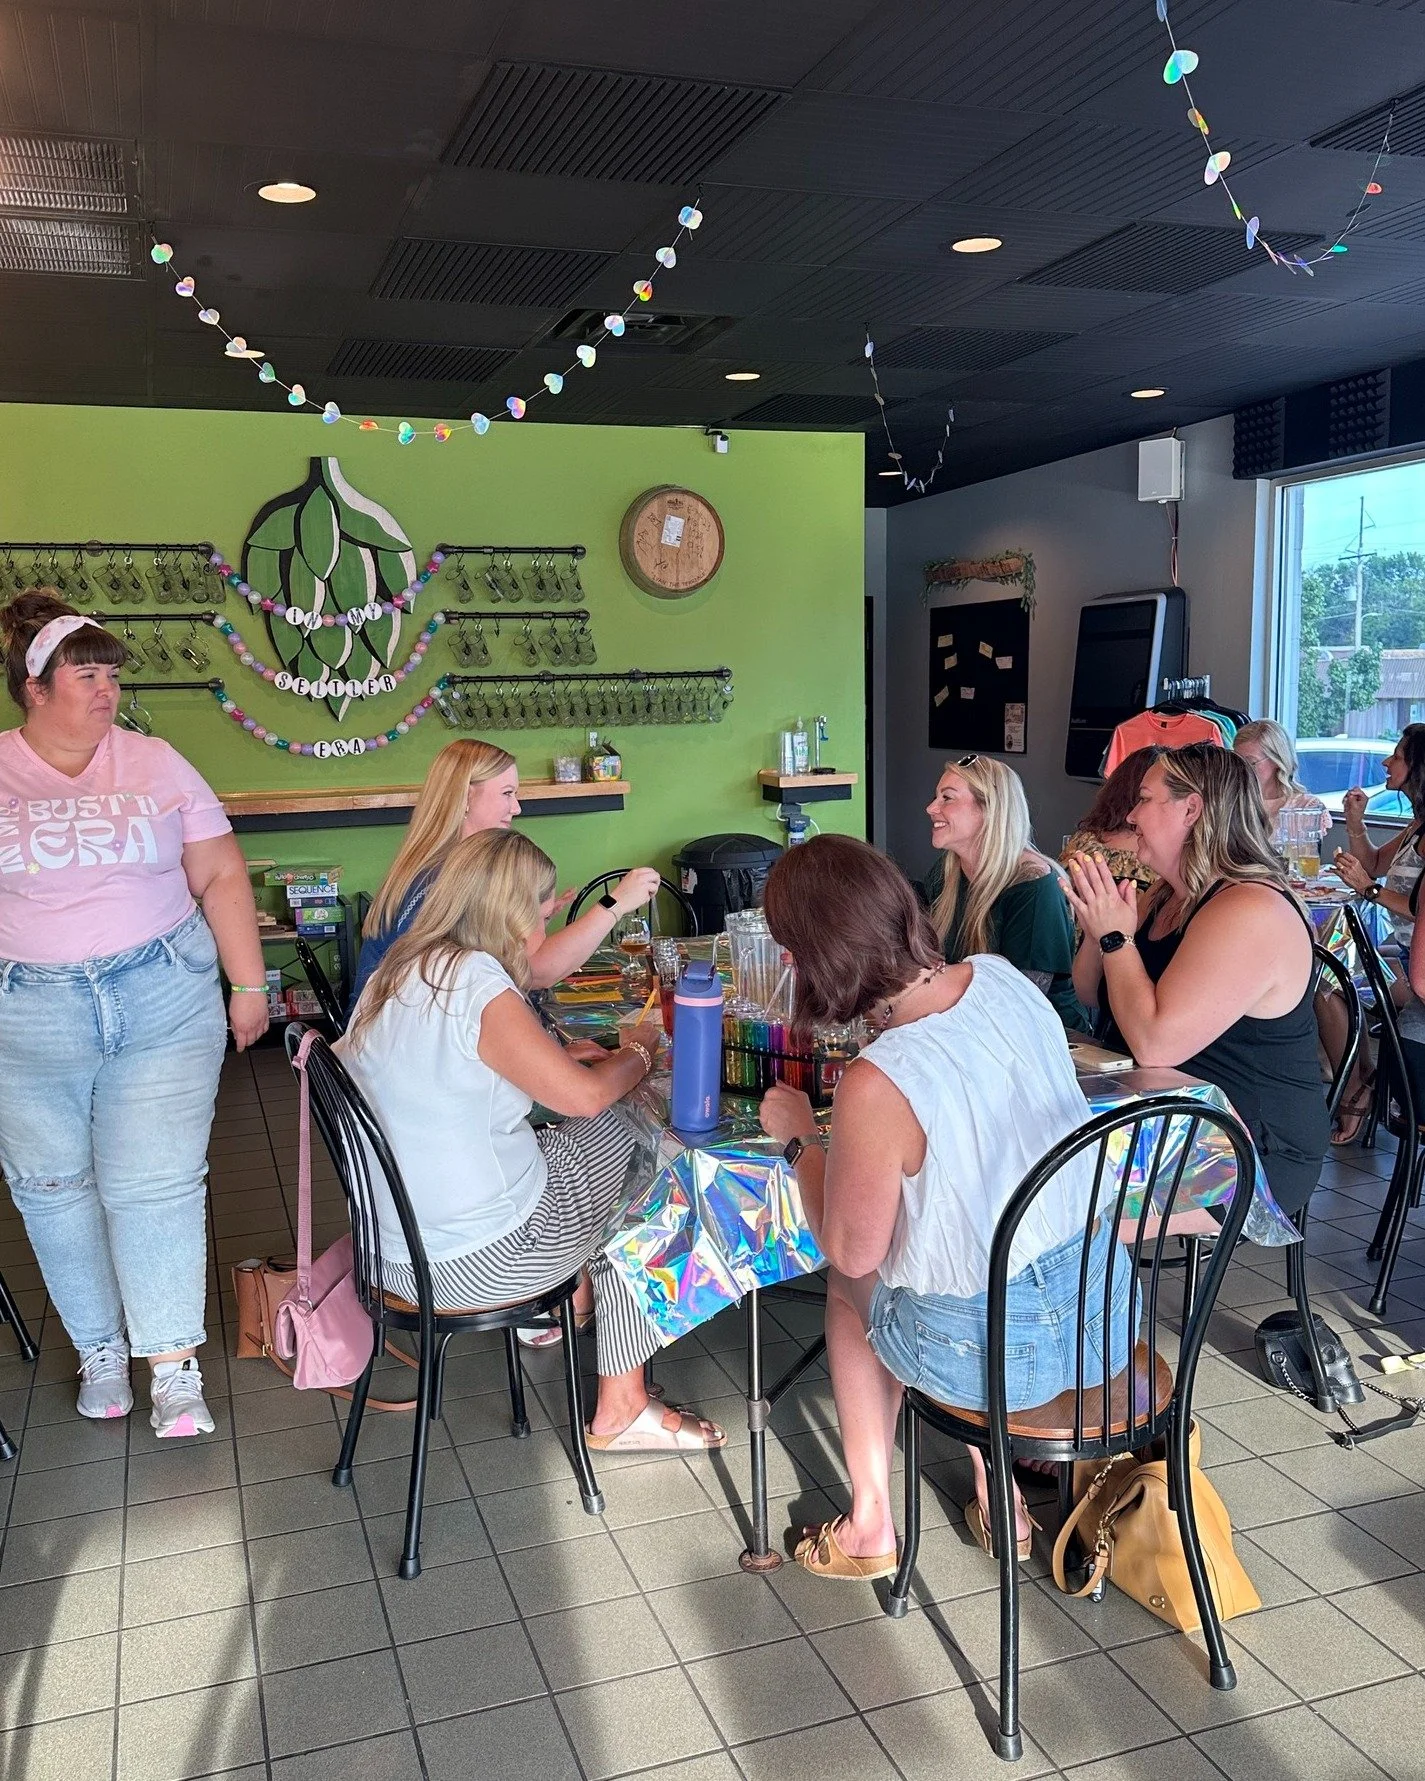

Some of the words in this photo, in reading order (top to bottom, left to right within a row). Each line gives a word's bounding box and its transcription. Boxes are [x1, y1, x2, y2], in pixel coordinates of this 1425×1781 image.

[290, 606, 319, 629] IN
[350, 603, 381, 625] MY
[277, 674, 395, 698] SELTZER
[317, 736, 362, 758] ERA
[29, 816, 158, 870] ERA
[289, 884, 336, 895] SEQUENCE
